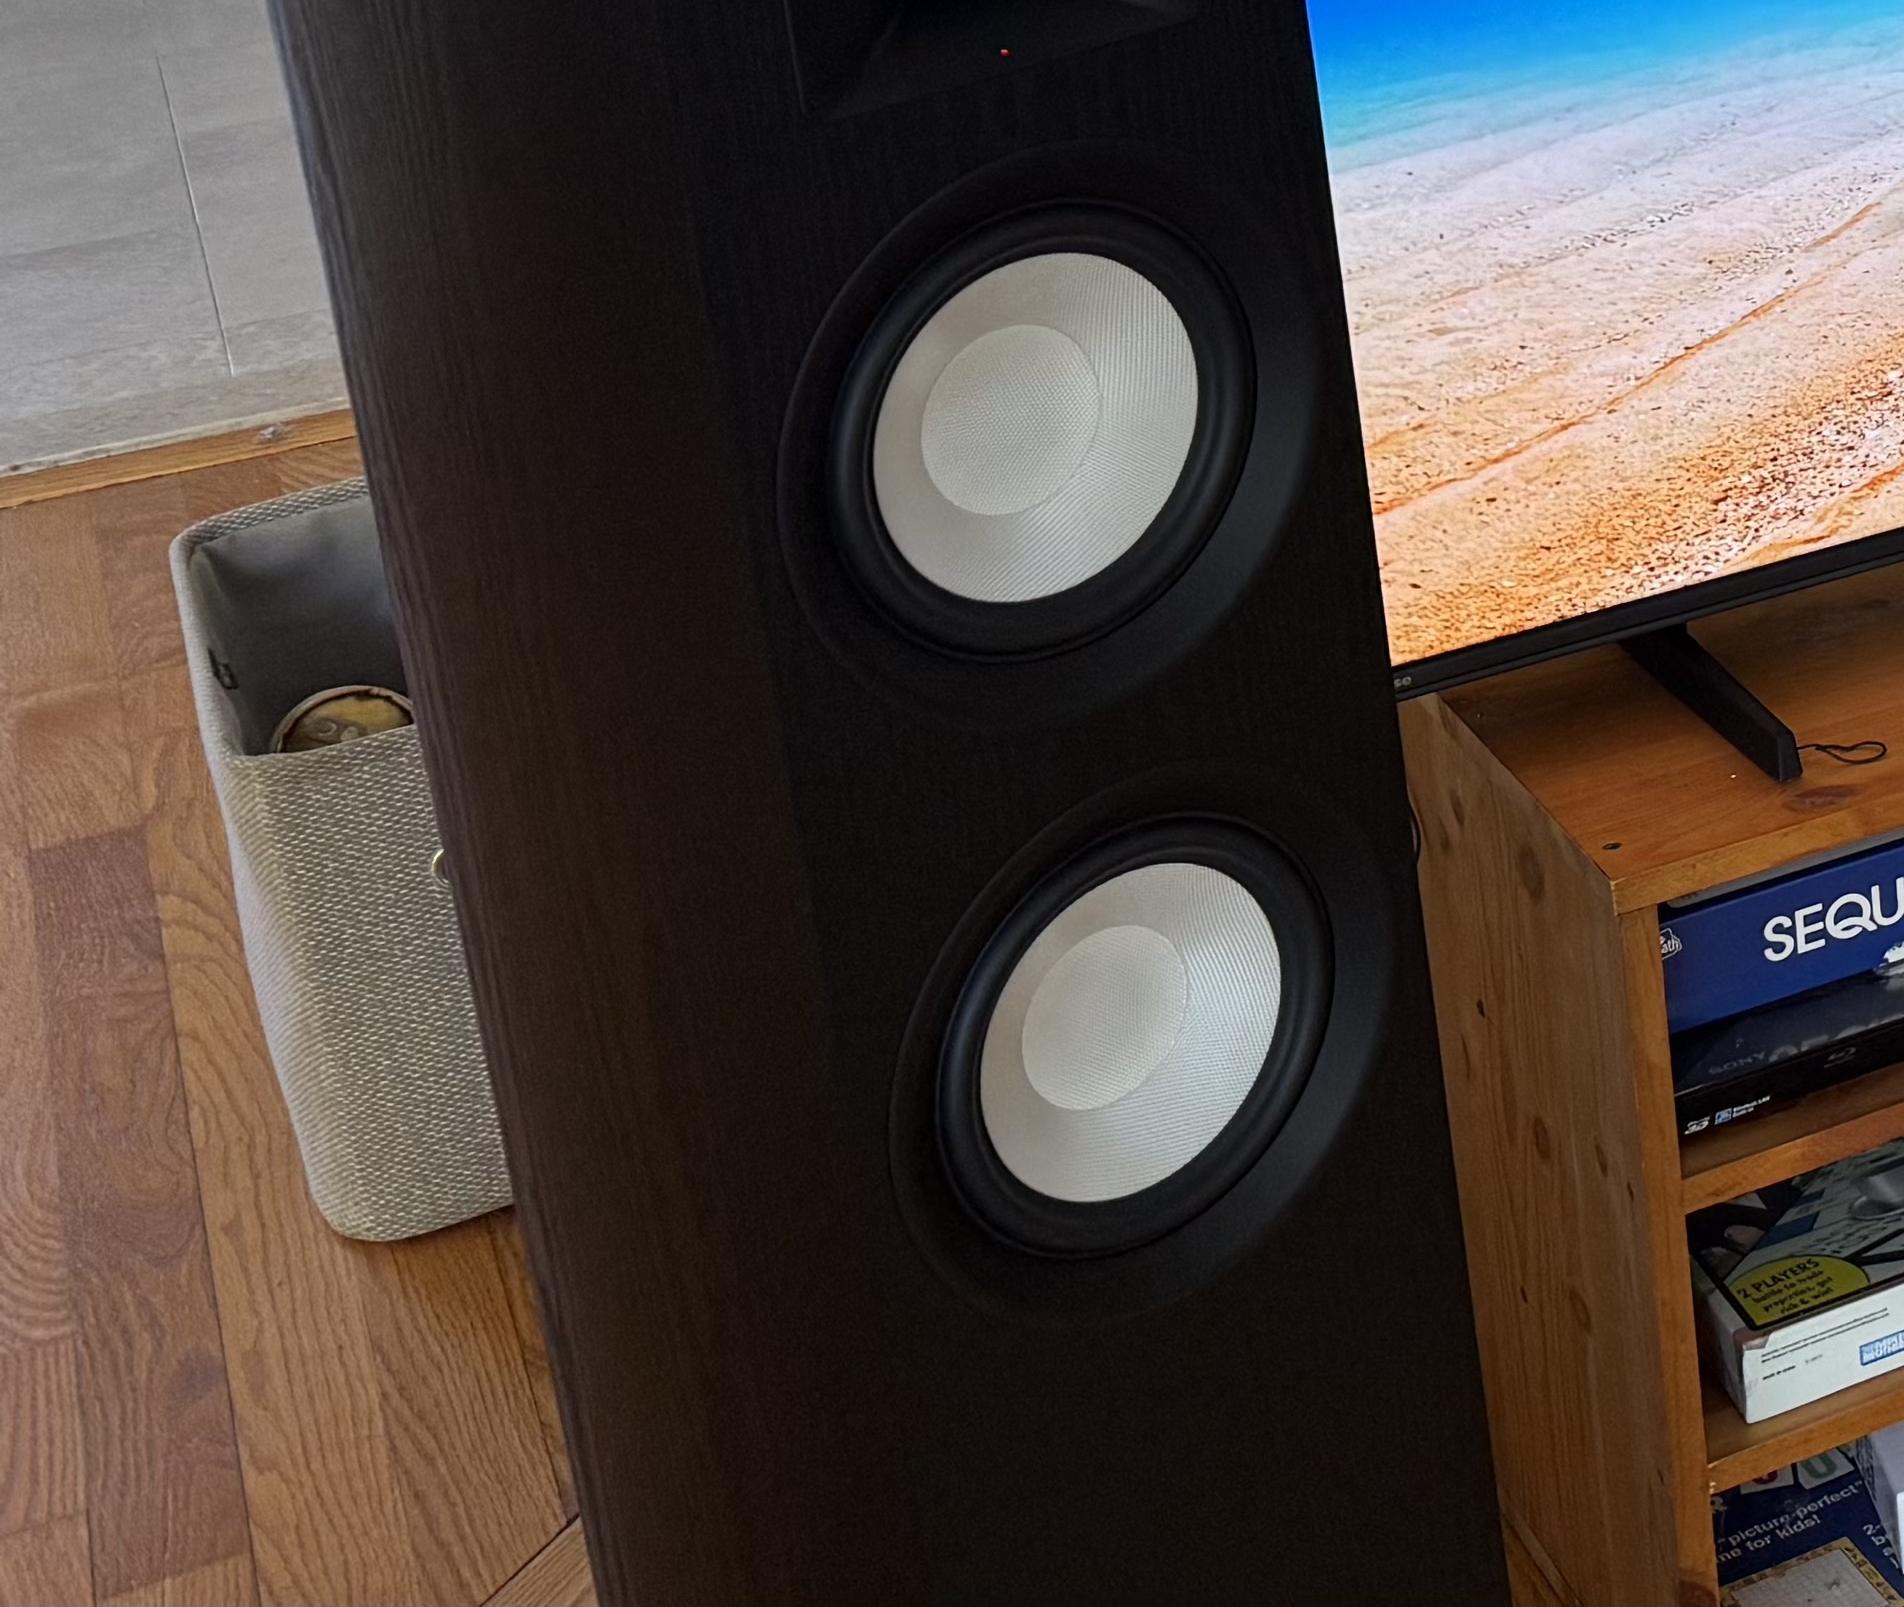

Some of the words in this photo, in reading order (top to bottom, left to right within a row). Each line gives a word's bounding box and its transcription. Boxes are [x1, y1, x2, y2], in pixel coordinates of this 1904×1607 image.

[1737, 1288, 1751, 1300] 2
[1751, 1258, 1820, 1292] PLAYERS
[1746, 1534, 1773, 1551] for
[1775, 1514, 1821, 1541] kids!
